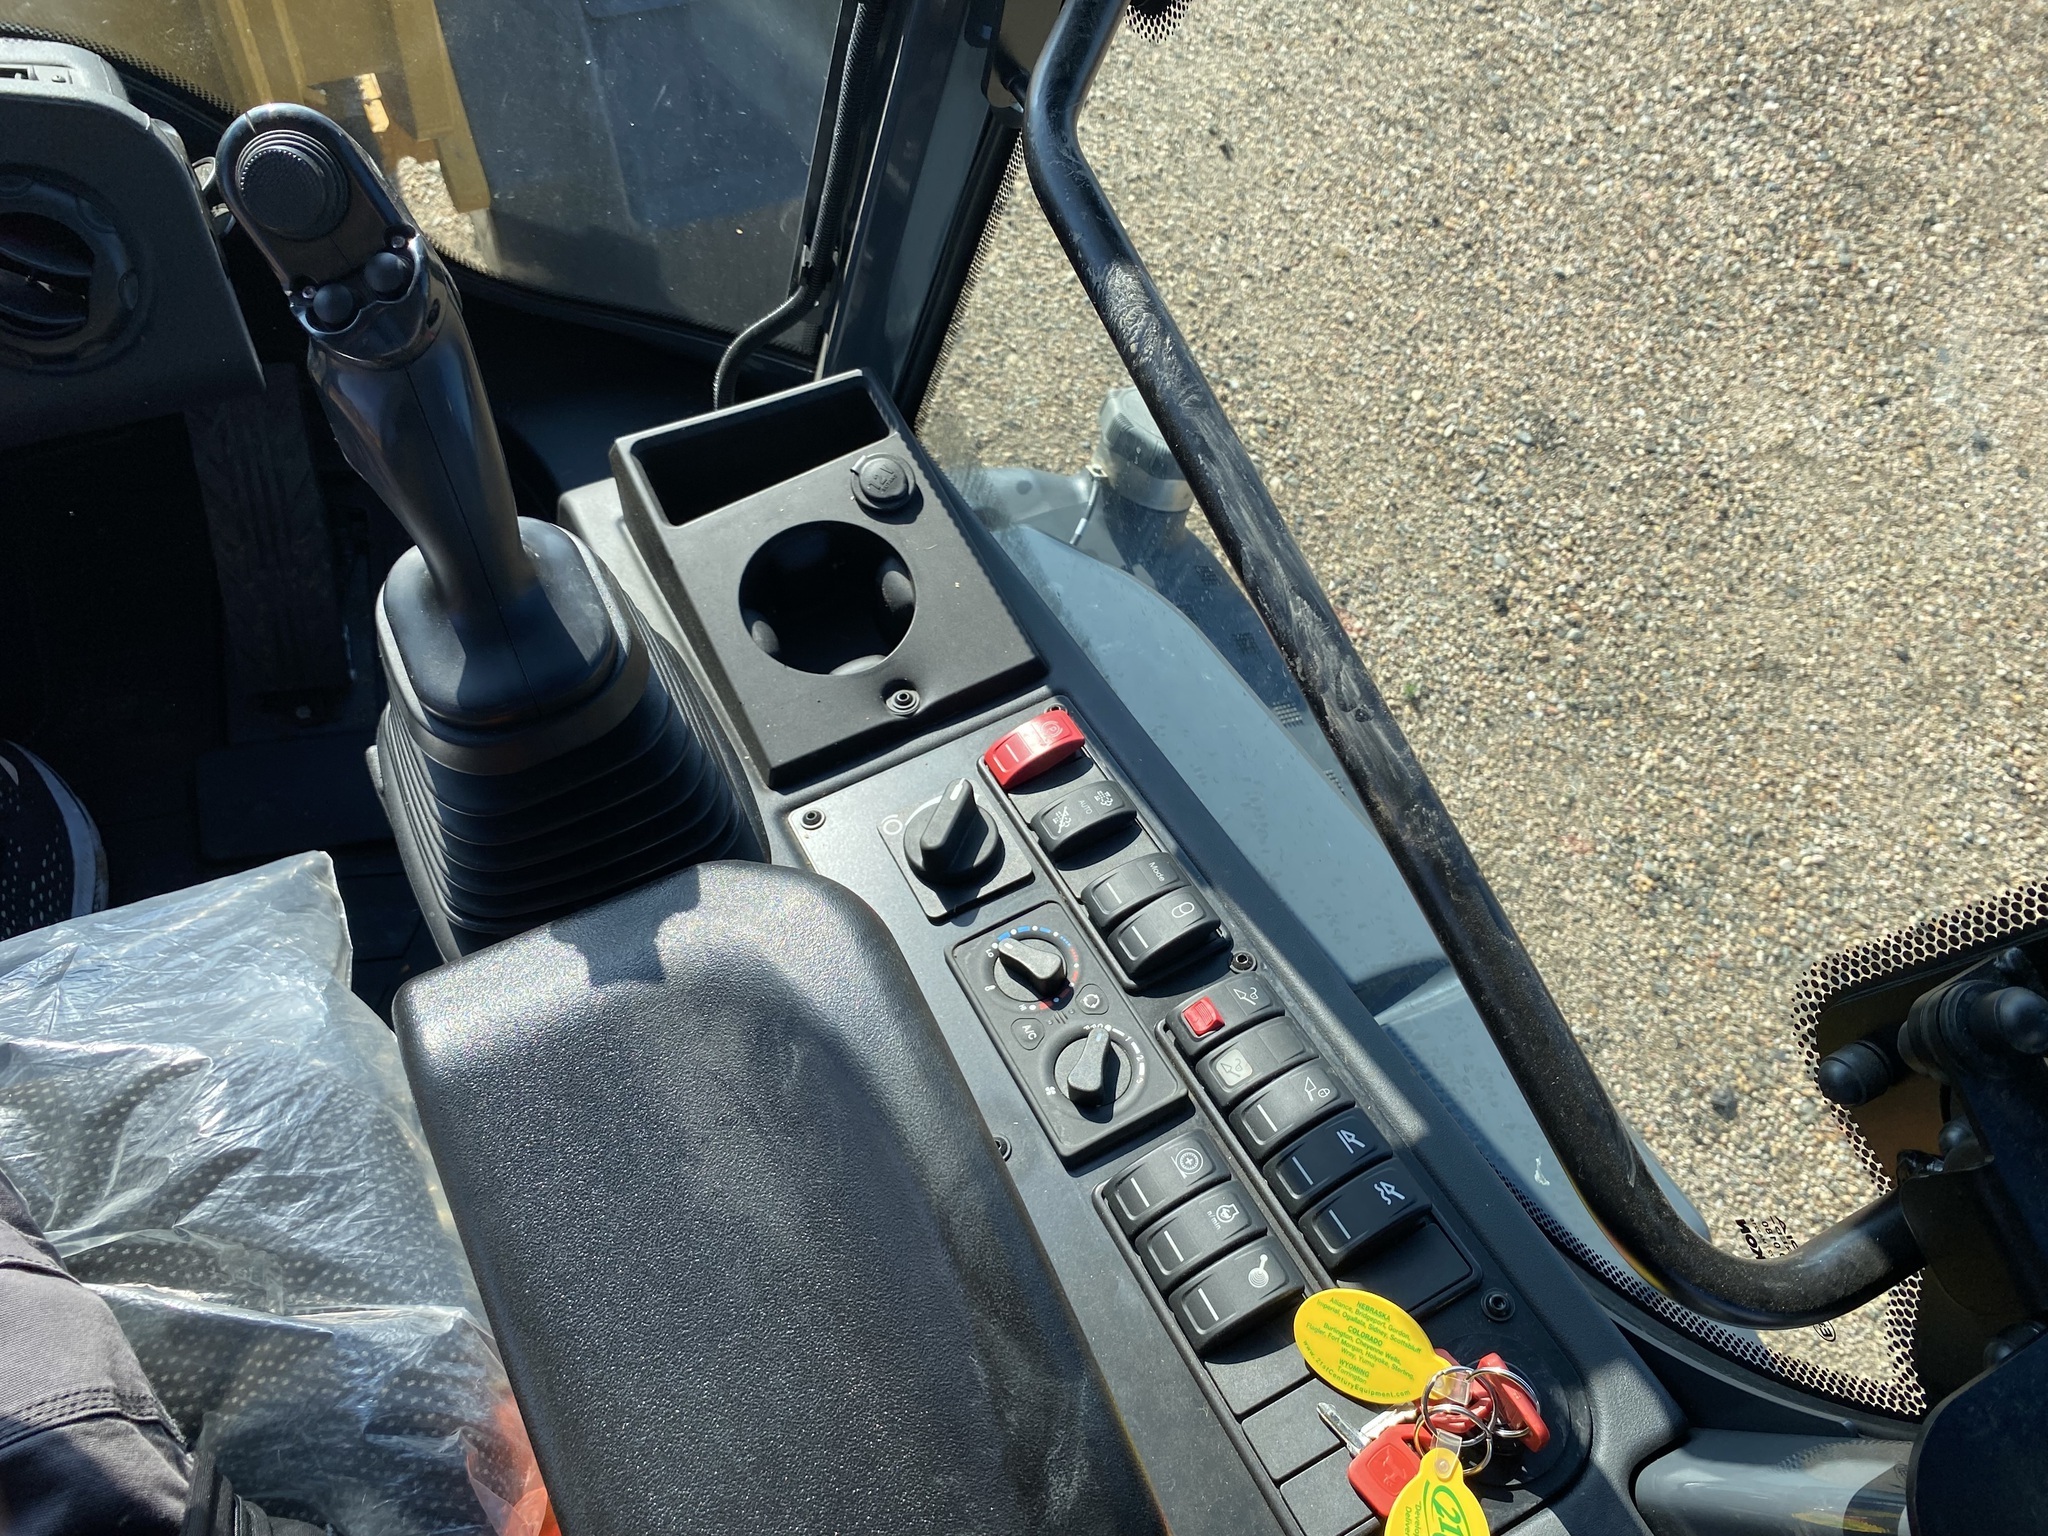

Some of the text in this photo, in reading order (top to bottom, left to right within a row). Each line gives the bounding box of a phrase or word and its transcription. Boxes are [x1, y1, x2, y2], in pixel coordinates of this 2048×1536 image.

[868, 464, 894, 491] 12V
[1078, 800, 1093, 815] AUTO
[1149, 861, 1165, 882] Mode
[985, 948, 994, 958] LO
[1022, 1024, 1037, 1040] A/C
[1330, 1297, 1410, 1340] Alliance, Bridgeport, Gordon,
[1357, 1301, 1391, 1322] NEBRASKA
[1316, 1299, 1421, 1354] Imperial, Ogallala, Sidney, Scottsbluff
[1347, 1325, 1383, 1347] COLORADO
[1323, 1322, 1354, 1342] Burlington,
[1355, 1337, 1384, 1356] Cheyenne
[1328, 1332, 1340, 1343] Fort
[1341, 1338, 1364, 1356] Morgan,
[1365, 1350, 1390, 1369] Holyoke,
[1341, 1347, 1375, 1369] Wray, Yuma
[1338, 1365, 1367, 1384] Torrington
[1339, 1357, 1370, 1378] WYOMING
